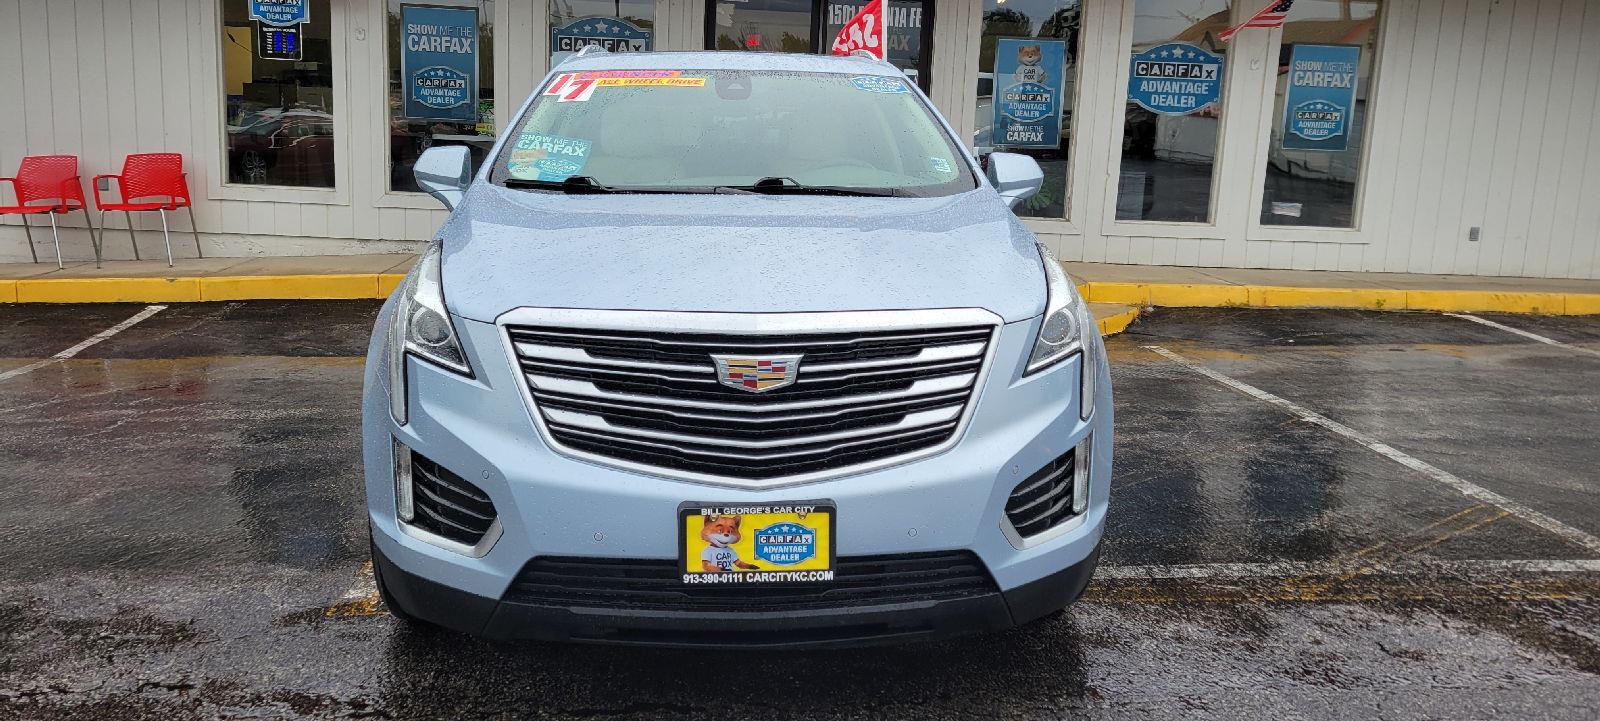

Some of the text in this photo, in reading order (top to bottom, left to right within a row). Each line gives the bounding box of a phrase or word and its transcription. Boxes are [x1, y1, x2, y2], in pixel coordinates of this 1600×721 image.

[259, 5, 299, 13] ADVANTAGE
[909, 8, 922, 28] FE
[407, 24, 472, 37] SHOW ME THE
[407, 34, 473, 54] CARFAX
[1137, 62, 1217, 80] CARFAX
[1295, 60, 1353, 73] SHOW ME THE
[416, 78, 465, 88] CARFAX
[1294, 71, 1354, 88] CARFAX
[546, 73, 597, 101] 17
[1140, 80, 1210, 95] ADVANTAGE
[420, 88, 461, 98] ADVANTAGE
[1005, 93, 1051, 102] CARFAX
[427, 96, 455, 105] DEALER
[1150, 94, 1196, 108] DEALER
[1008, 102, 1046, 111] ADVANTAGE
[1014, 110, 1040, 118] DEALER
[1297, 112, 1340, 121] CARFAX
[1007, 123, 1025, 132] SHOW
[1034, 125, 1044, 133] THE
[1298, 120, 1336, 129] ADVANTAGE
[1006, 131, 1043, 142] CARFAX
[1303, 128, 1329, 136] DEALER
[520, 134, 553, 143] SHOW
[554, 138, 569, 147] ME
[517, 140, 587, 157] CARFAX
[700, 505, 815, 516] BILL GEORGE'S CAR CITY
[760, 535, 812, 544] CARFAX
[763, 545, 808, 554] ADVANTAGE
[715, 552, 732, 561] CAR
[770, 553, 800, 562] DEALER
[716, 560, 732, 568] FOX
[683, 570, 834, 584] 913-390-0111 CARCITYKC.COM
